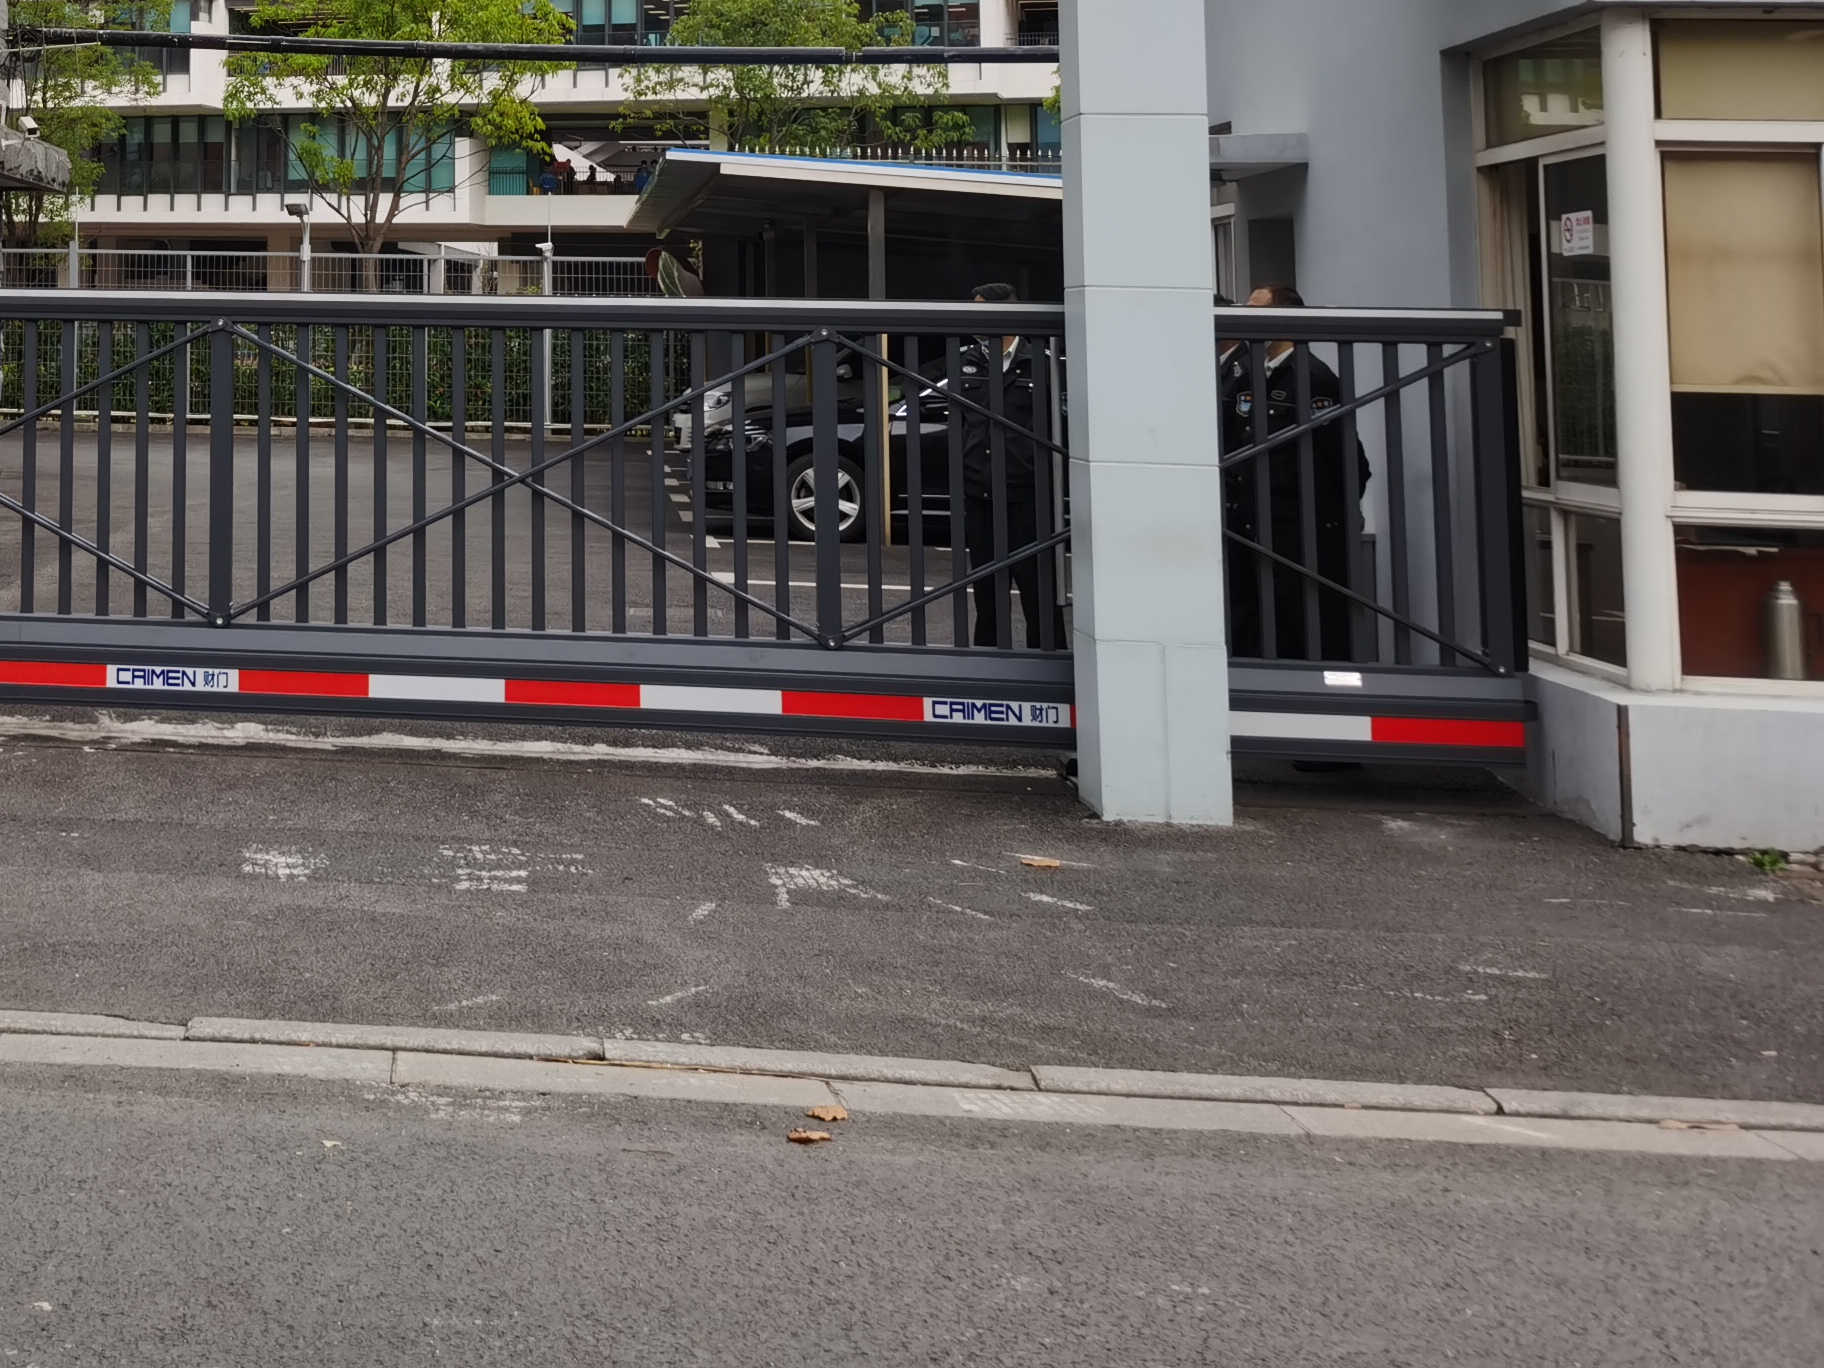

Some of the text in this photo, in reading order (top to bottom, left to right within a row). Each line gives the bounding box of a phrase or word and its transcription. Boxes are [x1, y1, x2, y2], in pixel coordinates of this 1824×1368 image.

[116, 667, 229, 689] CAIMEN 财门
[931, 700, 1059, 724] CAIMEN 财门
